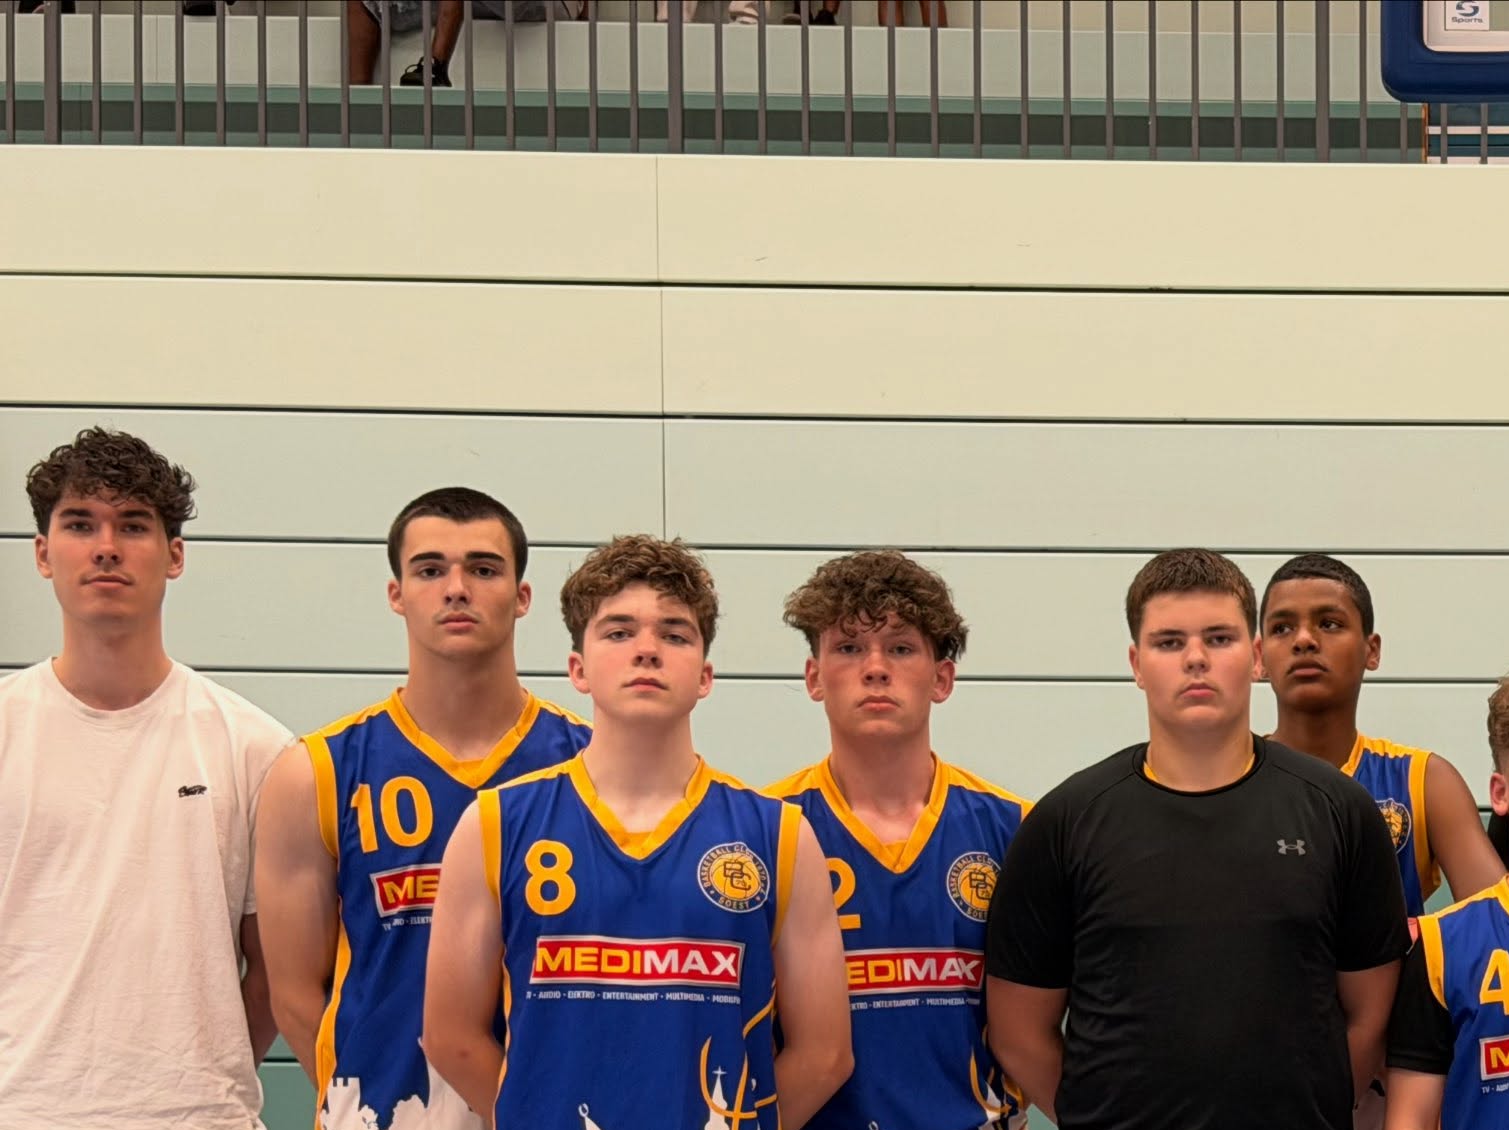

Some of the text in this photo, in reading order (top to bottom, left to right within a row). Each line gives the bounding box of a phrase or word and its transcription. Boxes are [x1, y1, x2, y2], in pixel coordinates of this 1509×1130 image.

[351, 775, 433, 853] 10
[525, 839, 576, 915] 8
[719, 896, 749, 909] SOEST
[825, 857, 861, 930] 2
[535, 946, 737, 977] MEDIMAX
[845, 958, 979, 985] EDIMAX
[602, 991, 659, 1001] ENTERTAINMENT
[665, 992, 705, 1002] MULTIMEDIA
